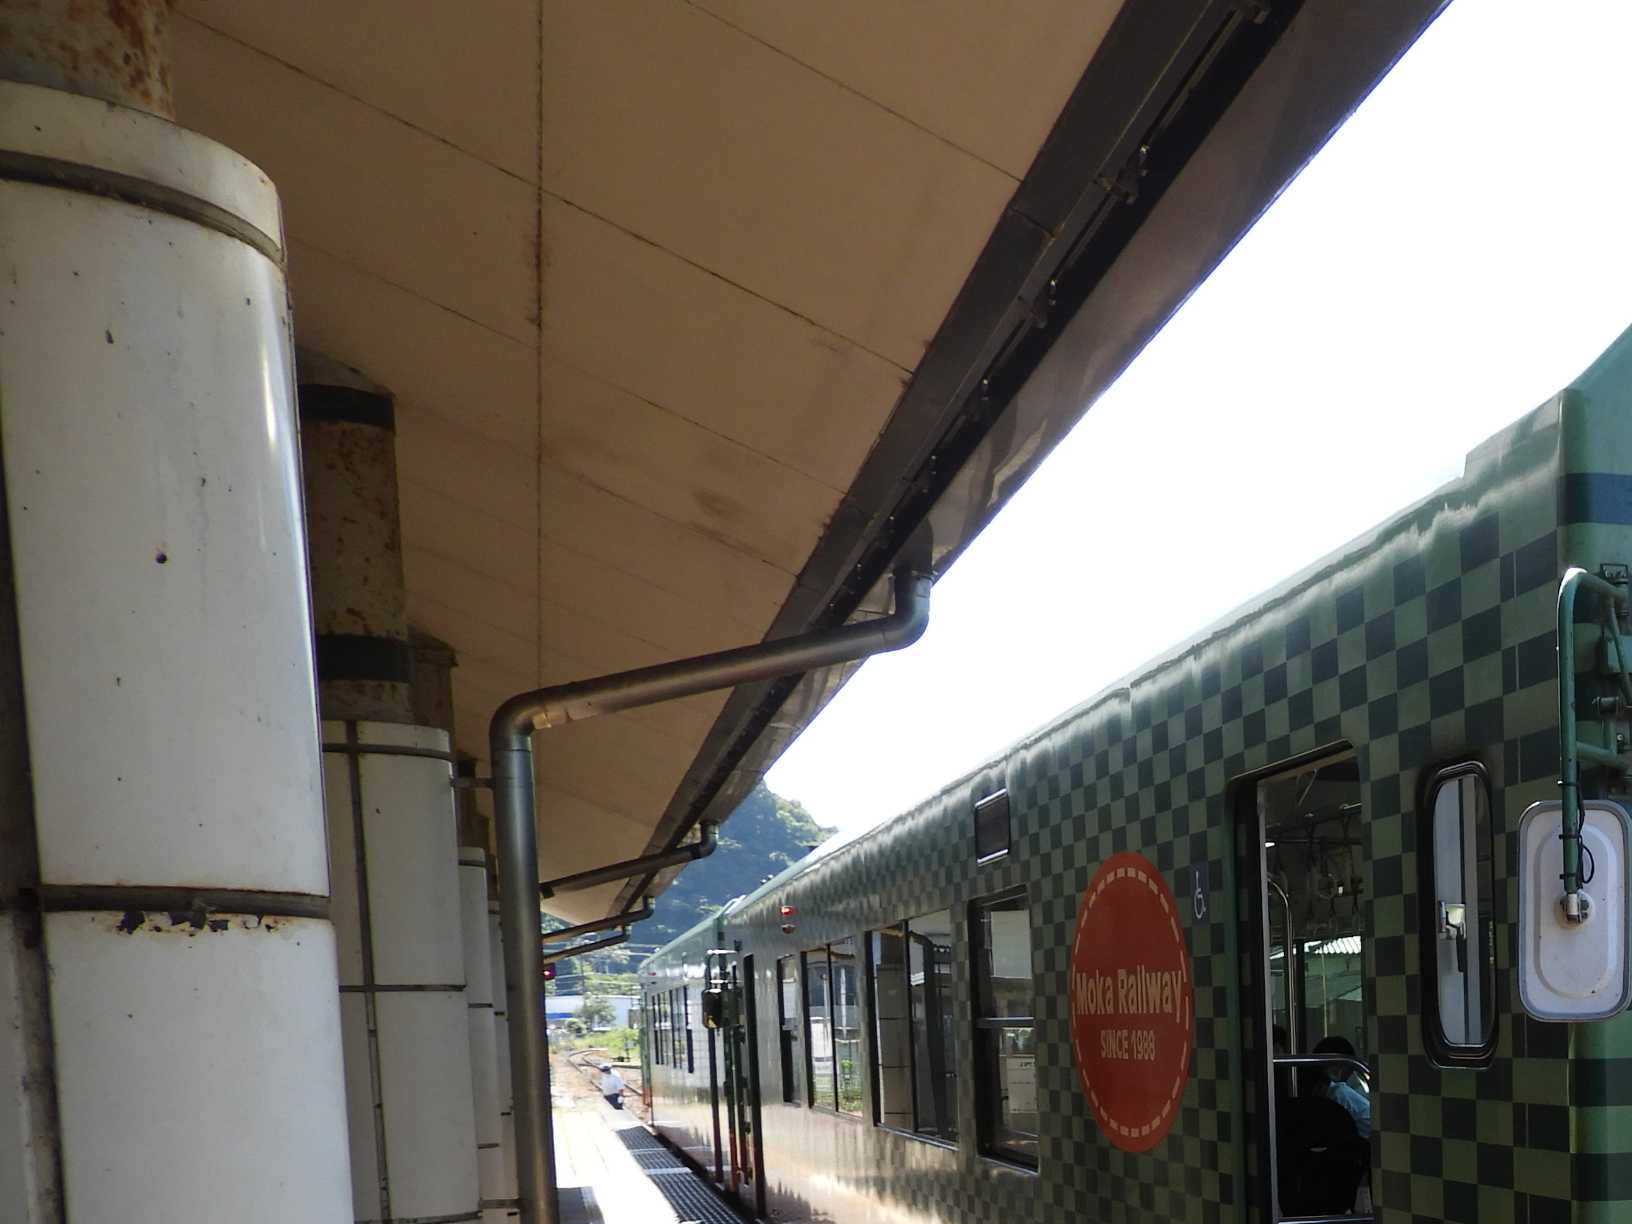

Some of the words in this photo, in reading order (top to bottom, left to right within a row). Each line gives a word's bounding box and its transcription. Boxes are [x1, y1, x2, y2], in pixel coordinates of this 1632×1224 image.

[1076, 968, 1114, 1015] Moka
[1118, 964, 1182, 1023] Railway
[1101, 1029, 1128, 1059] SINCE
[1131, 1029, 1155, 1061] 1988
